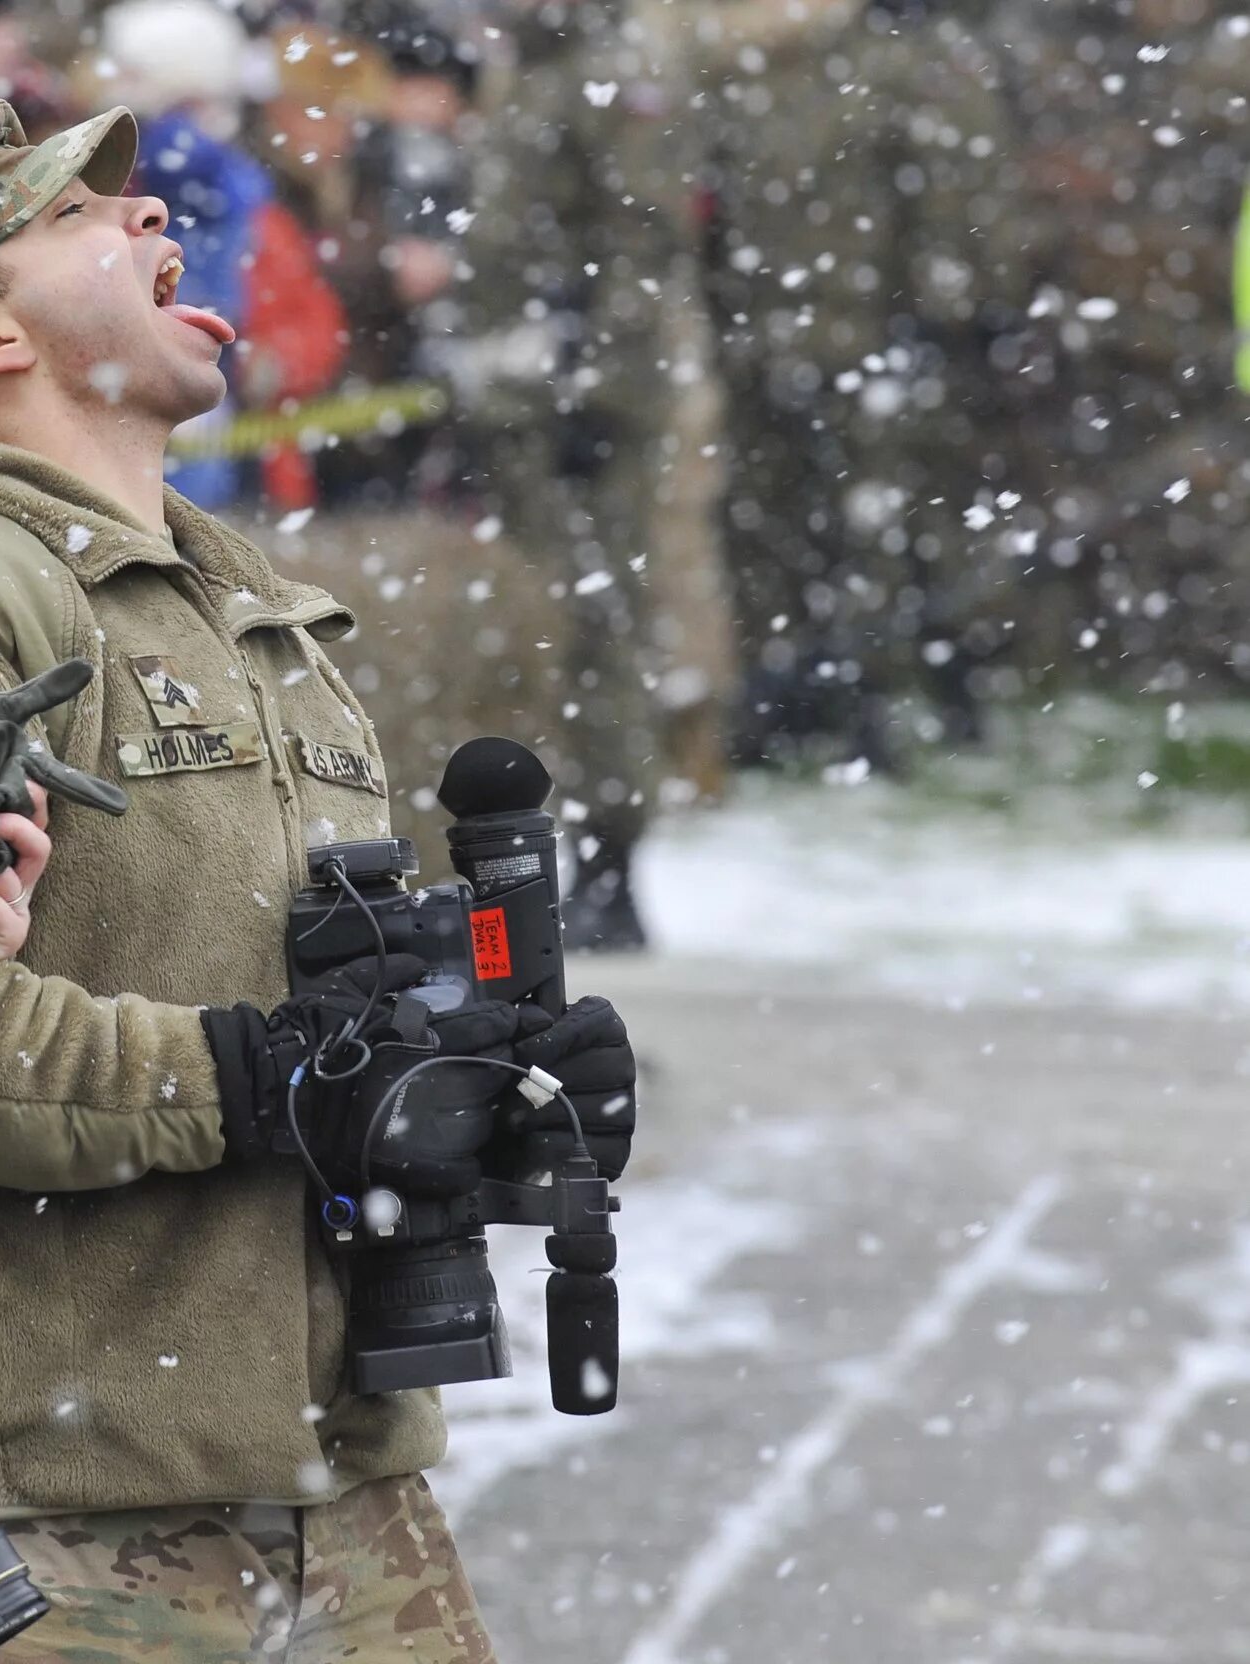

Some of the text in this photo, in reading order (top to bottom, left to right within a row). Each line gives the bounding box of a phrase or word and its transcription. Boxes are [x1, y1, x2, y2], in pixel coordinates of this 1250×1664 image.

[143, 732, 234, 769] HOLMES
[485, 915, 507, 975] TEAM 2
[478, 961, 489, 971] 3
